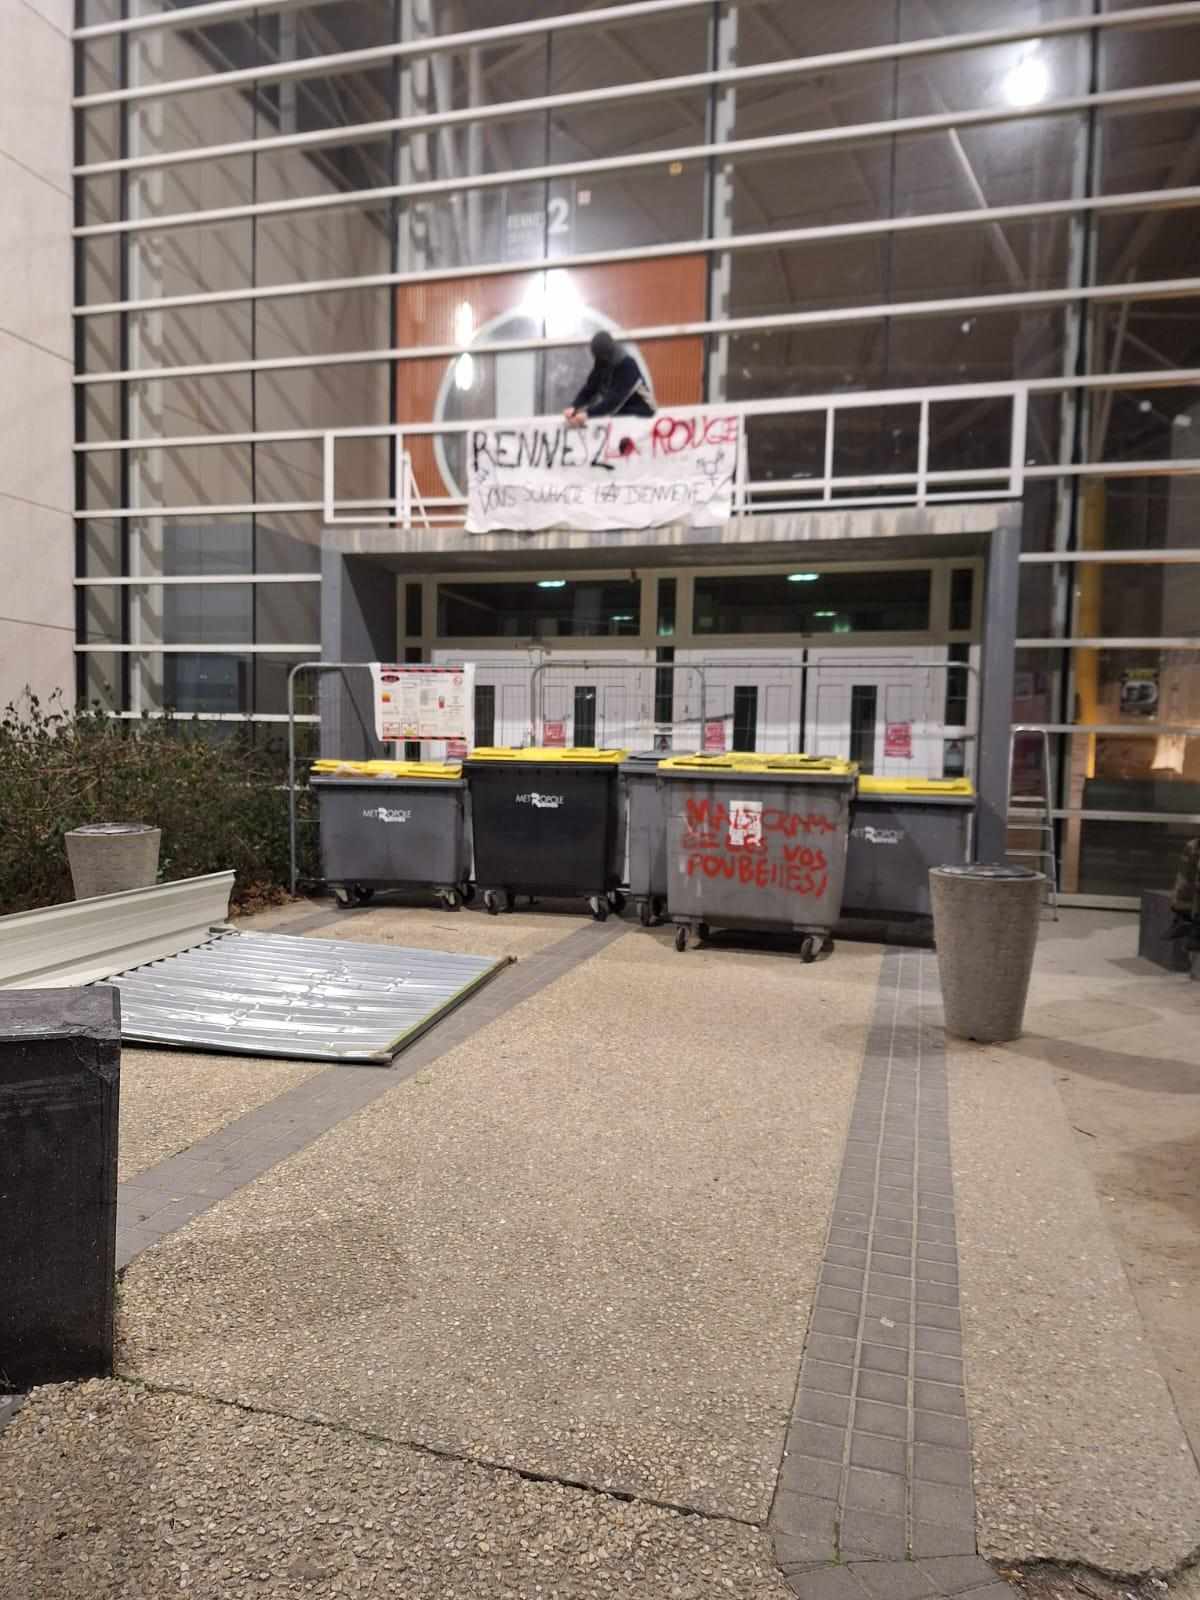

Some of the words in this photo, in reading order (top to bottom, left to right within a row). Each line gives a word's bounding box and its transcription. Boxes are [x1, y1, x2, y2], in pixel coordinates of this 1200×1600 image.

[548, 197, 569, 232] 2
[473, 427, 587, 472] RENNES
[590, 425, 614, 470] 2
[651, 416, 737, 457] ROUGE
[783, 844, 828, 871] VOS
